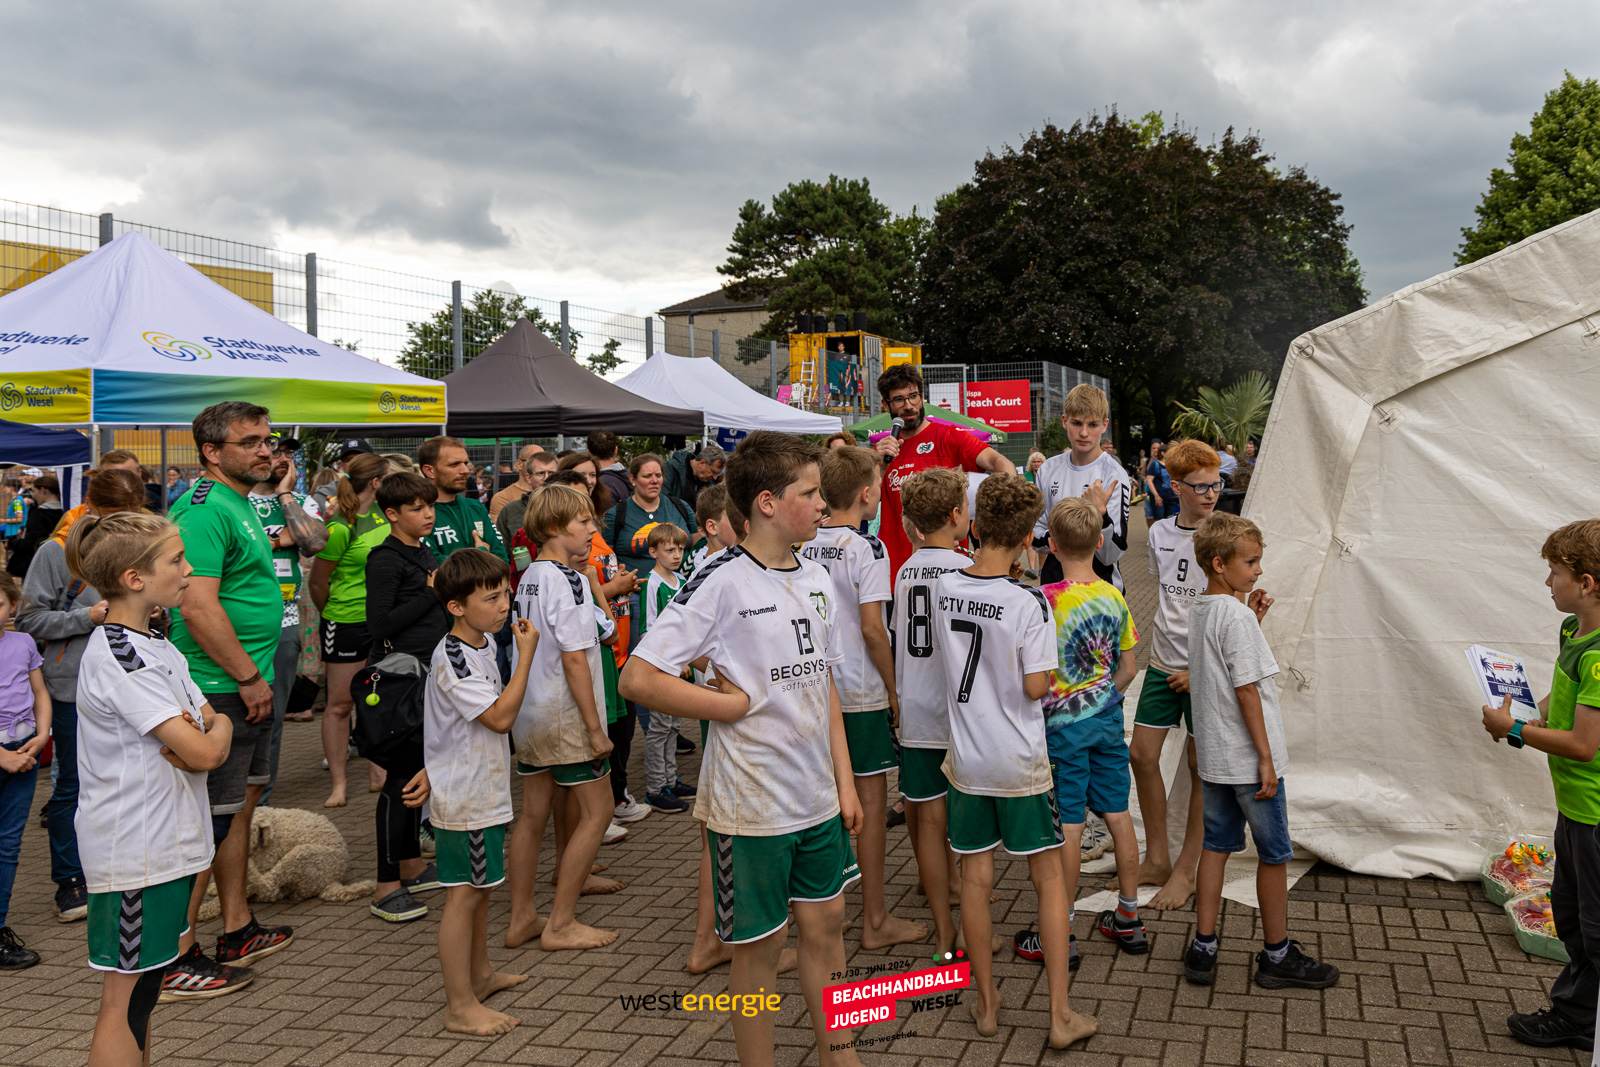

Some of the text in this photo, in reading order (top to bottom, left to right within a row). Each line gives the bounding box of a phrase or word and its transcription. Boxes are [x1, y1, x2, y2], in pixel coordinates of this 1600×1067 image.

[203, 336, 321, 357] Stadtwerke
[216, 349, 288, 363] Wesel
[24, 385, 78, 396] Stadtwerke
[25, 397, 54, 407] Wesel
[398, 394, 438, 404] Stadtwerke
[994, 397, 1022, 406] Court
[398, 403, 422, 411] Wesel
[433, 529, 460, 545] TR
[820, 546, 844, 561] RHEDE
[1177, 558, 1189, 583] 9
[748, 604, 778, 616] hummel
[939, 595, 1005, 621] HCTV RHEDE
[907, 585, 934, 658] 8
[790, 618, 815, 656] 13
[950, 618, 983, 703] 7
[770, 658, 825, 682] BEOSYS
[781, 678, 821, 693] software
